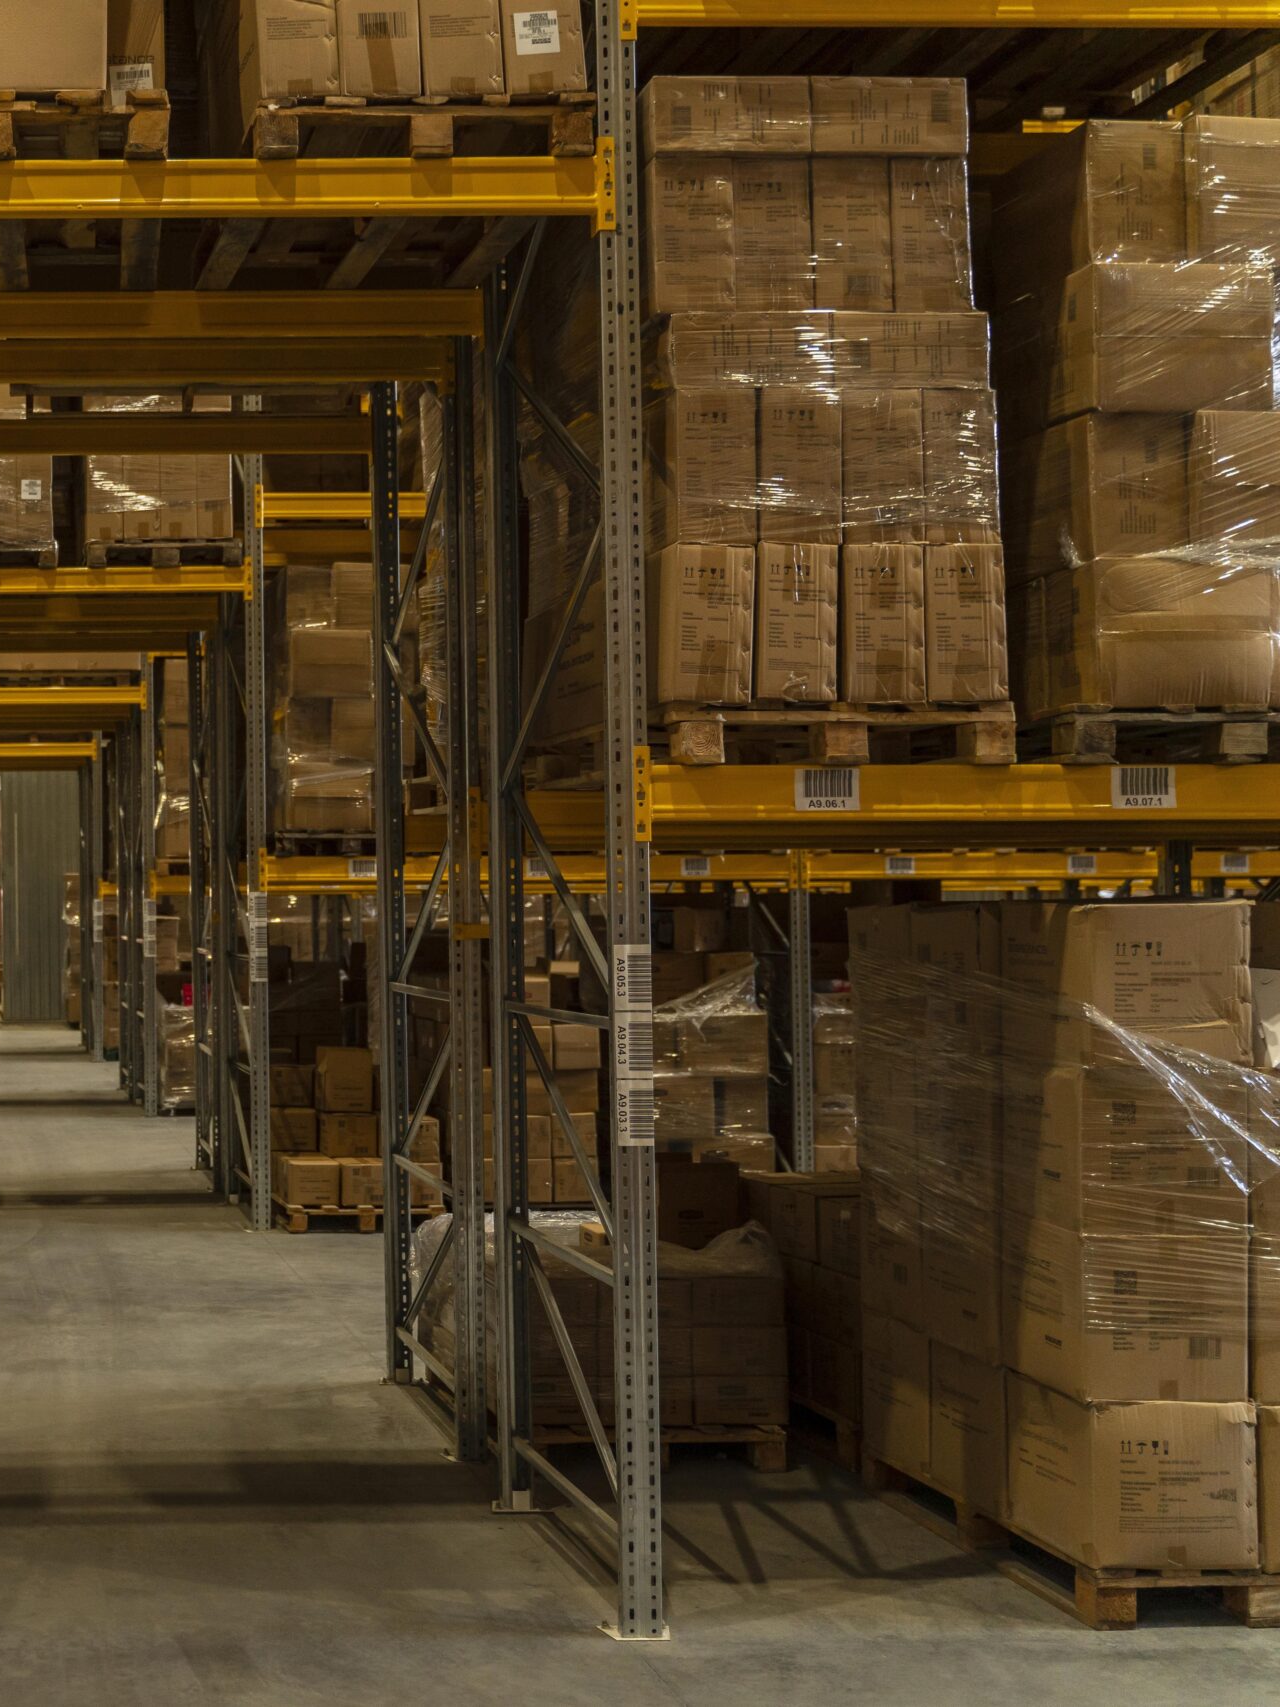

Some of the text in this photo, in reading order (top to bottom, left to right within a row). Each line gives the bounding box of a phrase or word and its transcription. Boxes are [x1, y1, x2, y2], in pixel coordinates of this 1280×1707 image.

[808, 800, 846, 808] A9.06.1
[1125, 797, 1162, 806] A9.07.1
[616, 958, 626, 998] A9.05.3
[618, 1025, 627, 1065] A9.04.3
[618, 1093, 628, 1133] A9.03.3
